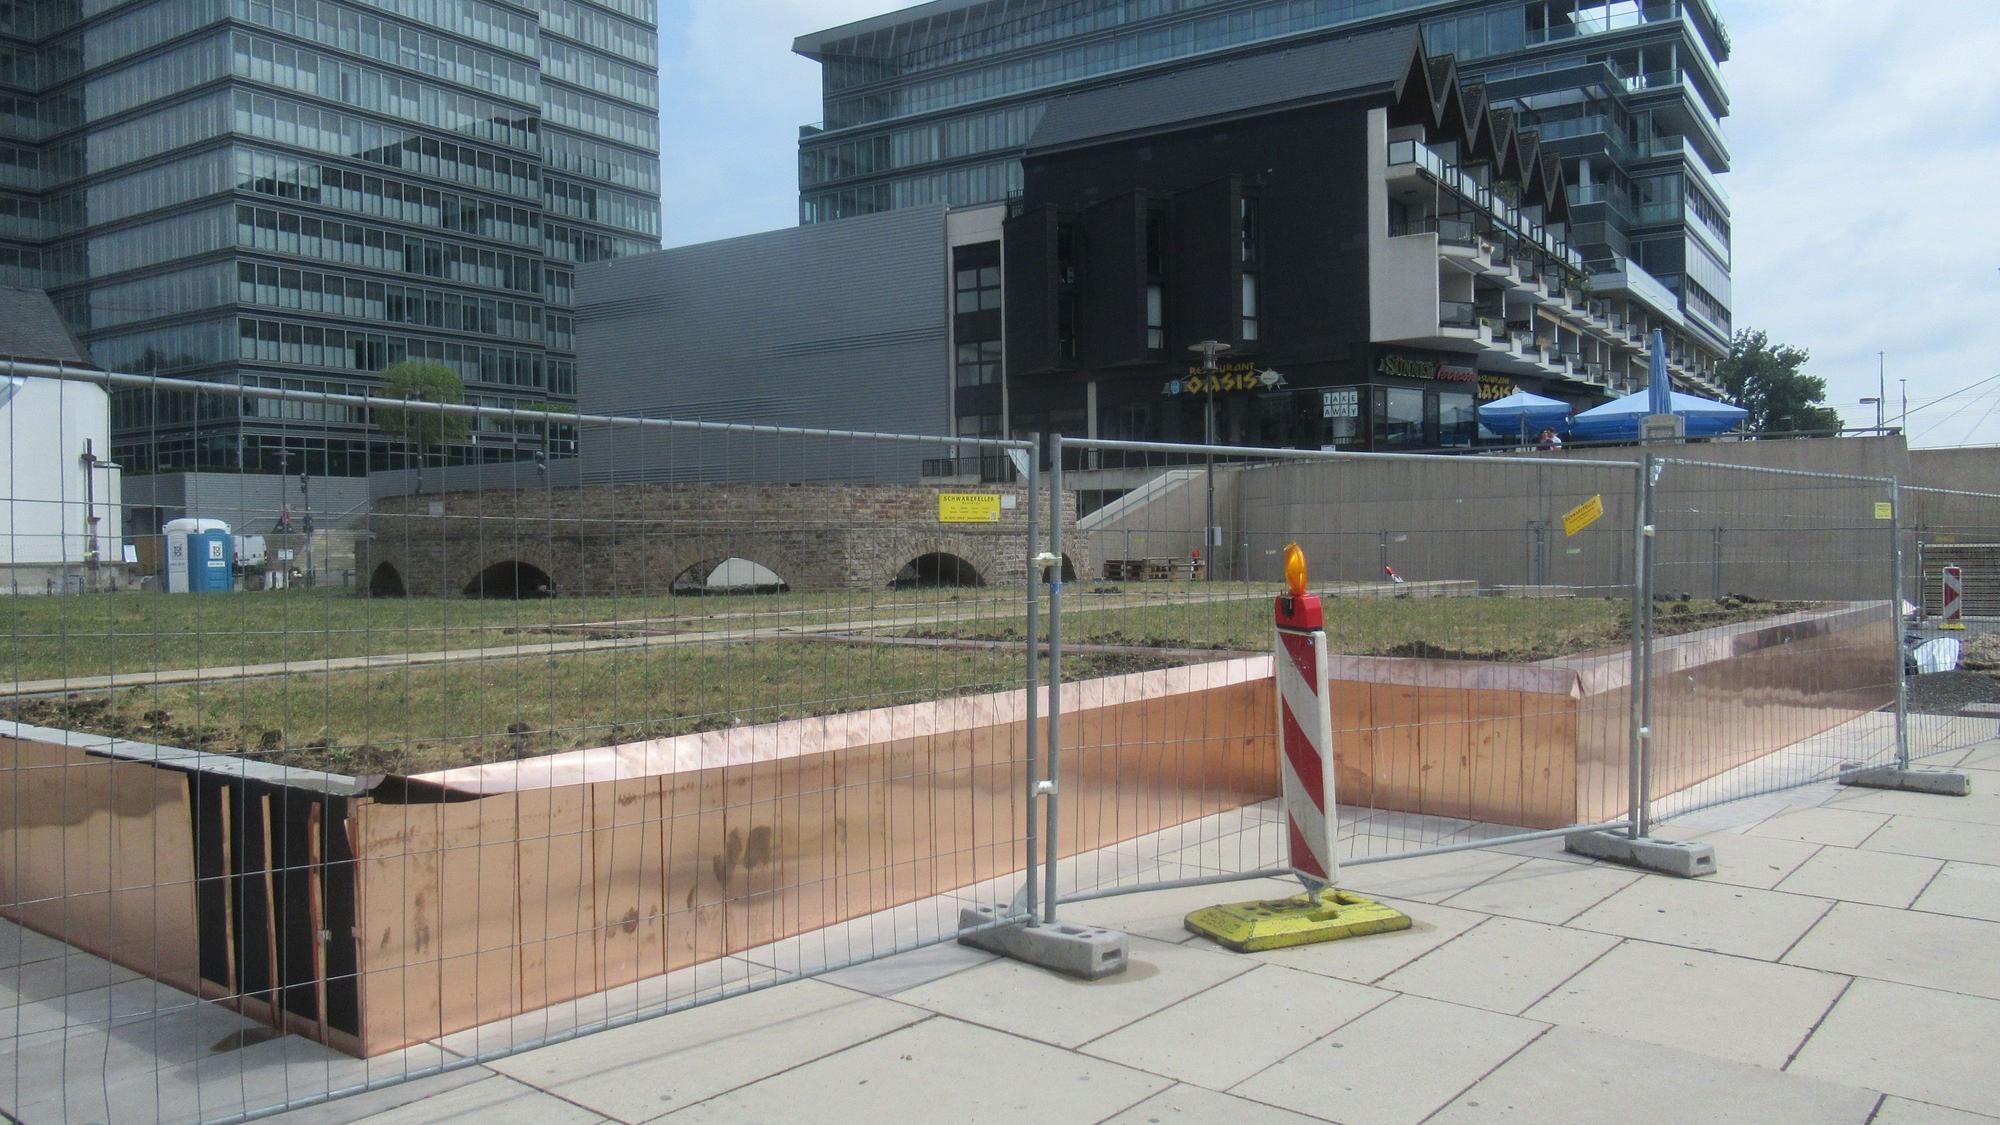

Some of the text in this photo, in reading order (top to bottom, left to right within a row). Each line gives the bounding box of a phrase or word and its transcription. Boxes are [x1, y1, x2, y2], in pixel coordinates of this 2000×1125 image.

[1187, 371, 1258, 394] OASIS
[1325, 394, 1357, 402] TAKE
[1325, 407, 1357, 416] AWAY
